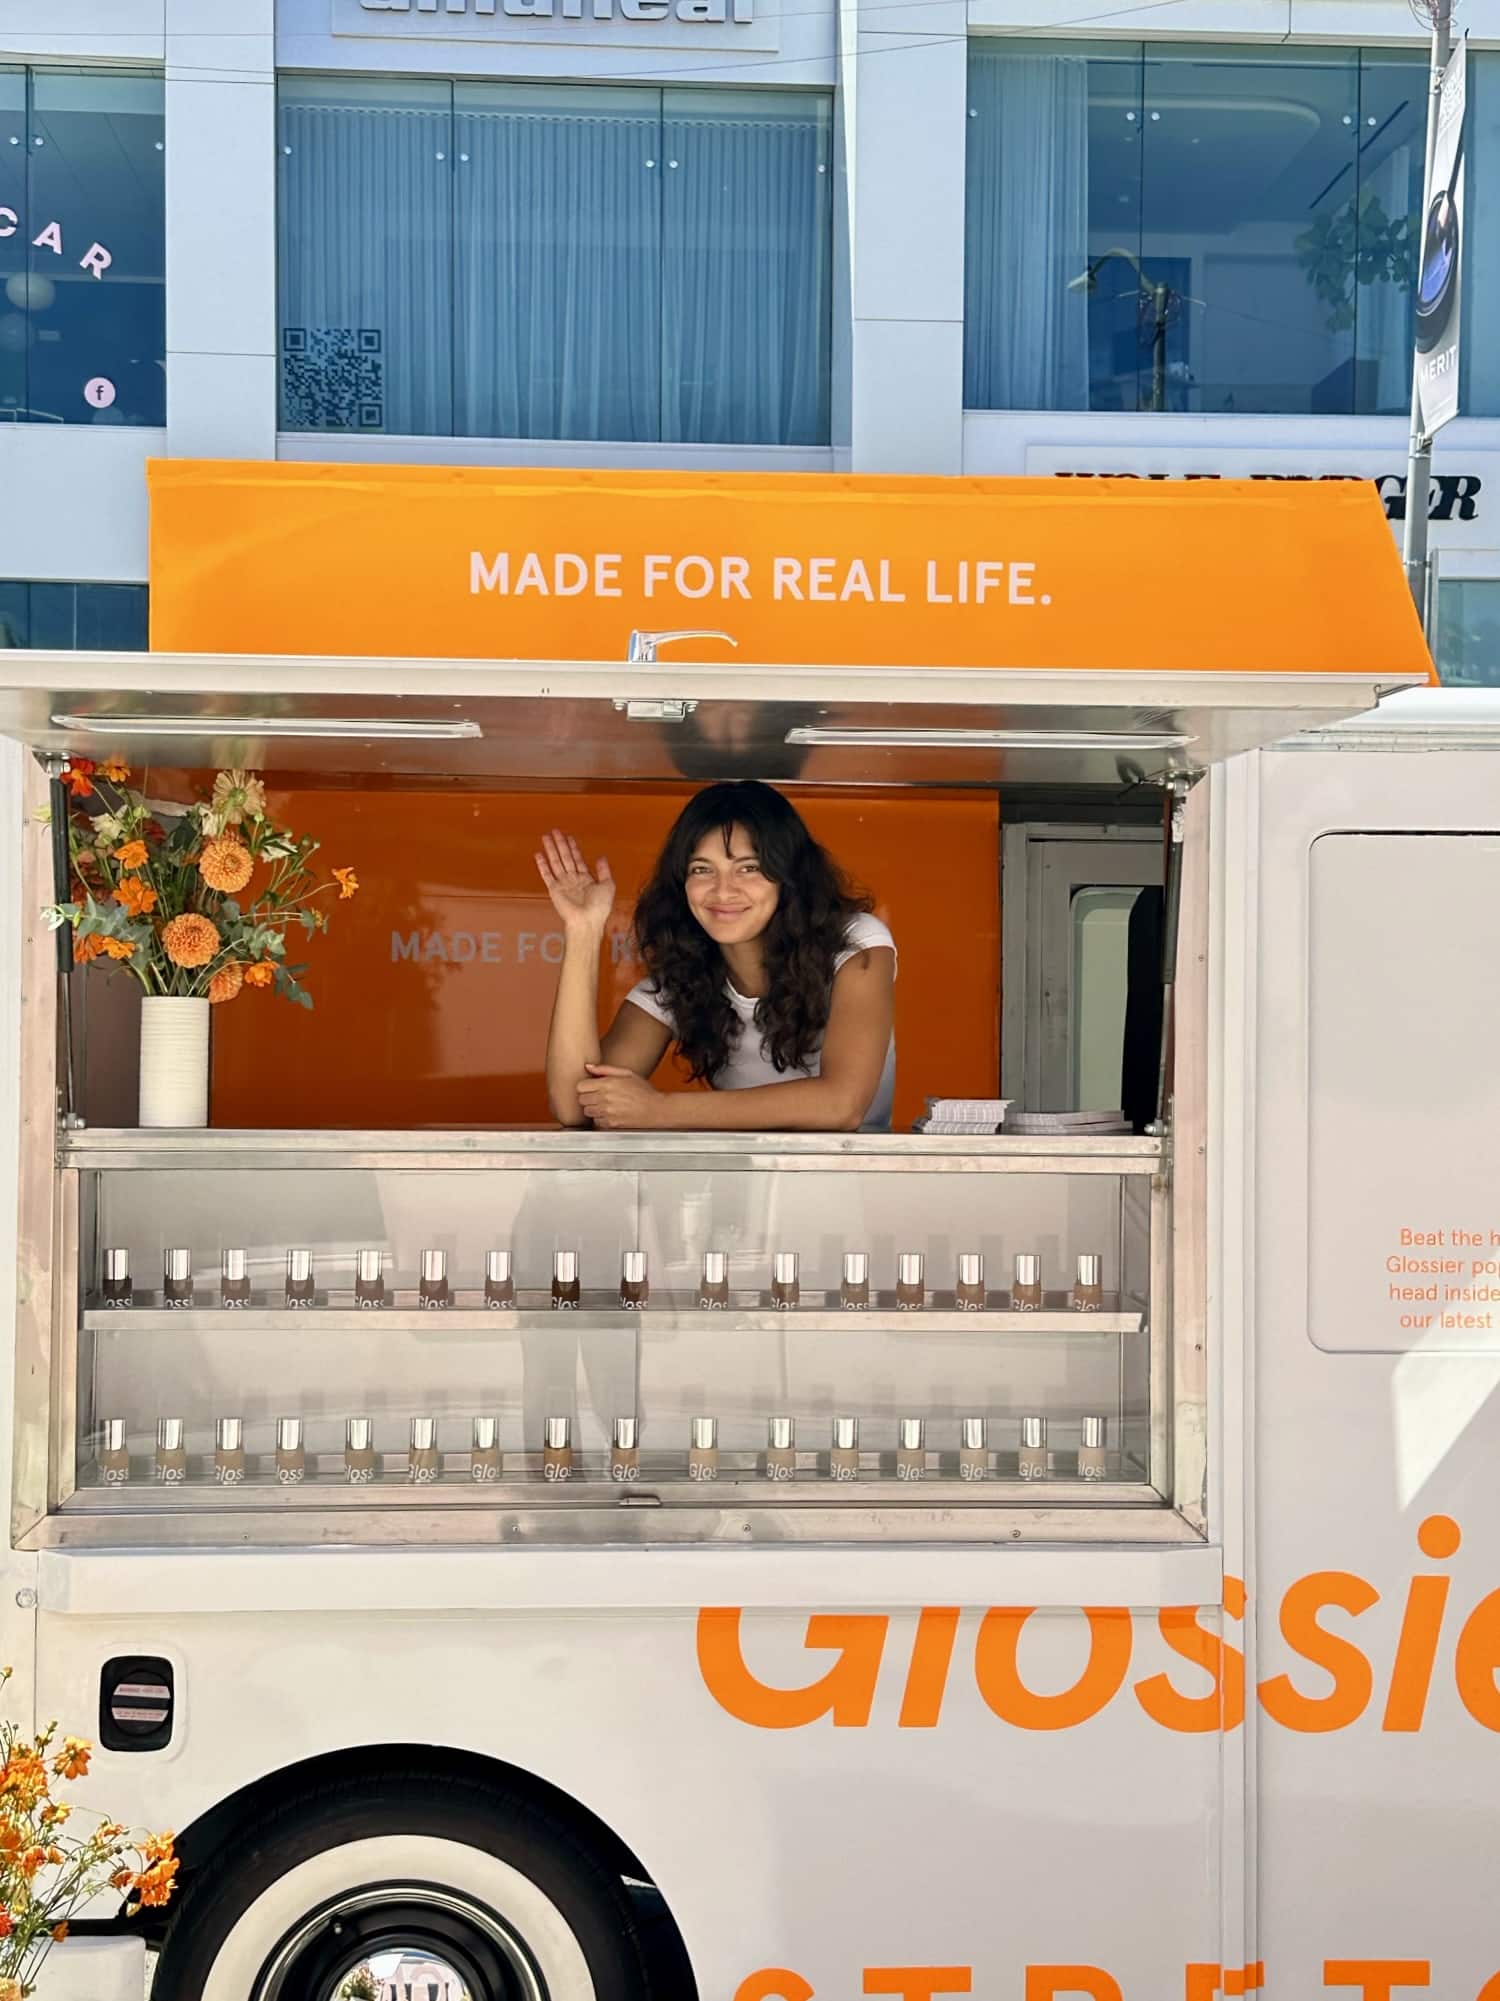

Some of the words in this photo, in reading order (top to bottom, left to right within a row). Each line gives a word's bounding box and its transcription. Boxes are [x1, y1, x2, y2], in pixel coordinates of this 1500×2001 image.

[469, 551, 623, 597] MADE
[643, 554, 752, 599] FOR
[772, 557, 907, 602] REAL
[926, 560, 1052, 606] LIFE.
[391, 930, 502, 963] MADE
[516, 931, 566, 964] FO
[1400, 1228, 1444, 1246] Beat
[1452, 1229, 1483, 1247] the
[1386, 1255, 1465, 1273] Glossier
[1390, 1283, 1438, 1301] head
[1444, 1284, 1500, 1301] inside
[1400, 1316, 1432, 1329] our
[1440, 1311, 1493, 1329] latest
